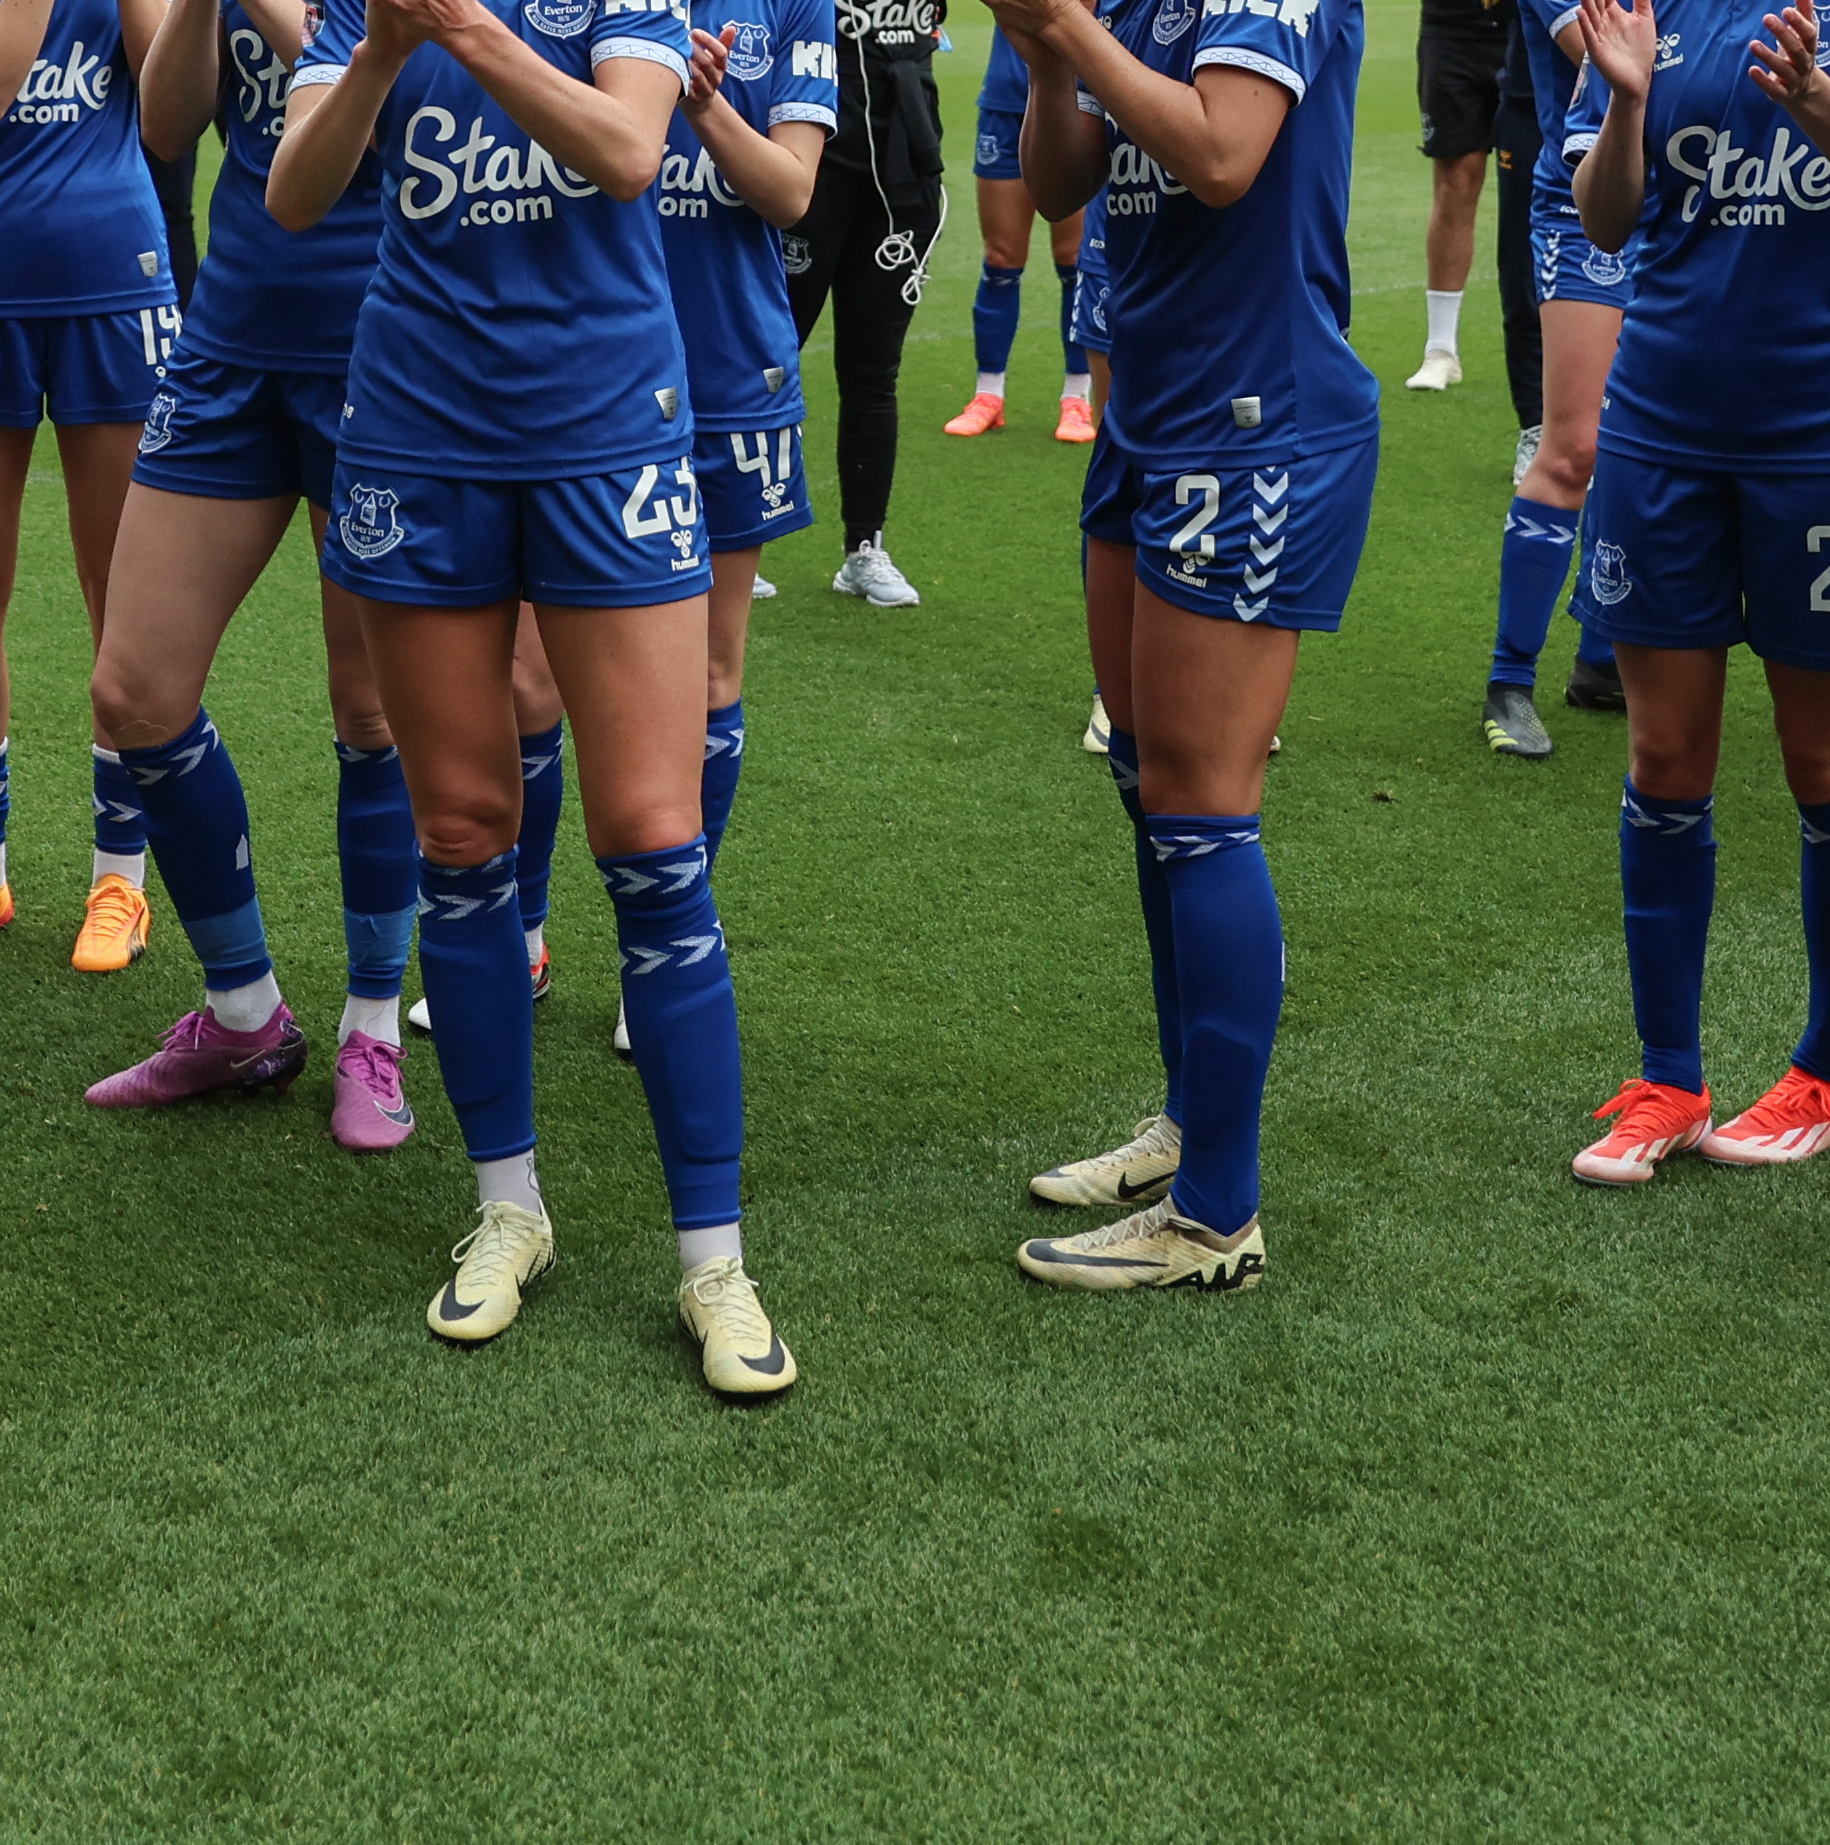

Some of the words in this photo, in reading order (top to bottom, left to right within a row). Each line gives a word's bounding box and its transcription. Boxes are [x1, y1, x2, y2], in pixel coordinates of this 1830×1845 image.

[544, 5, 582, 16] Everton
[875, 29, 915, 44] .com
[729, 50, 760, 64] Everton
[792, 40, 838, 86] KI
[16, 40, 112, 111] take
[9, 103, 79, 124] .com
[400, 106, 599, 220] Stak
[460, 194, 553, 227] .com
[658, 196, 708, 219] om
[1106, 190, 1157, 216] com
[1710, 202, 1785, 226] .com
[621, 455, 698, 540] 23
[761, 500, 795, 521] hummel
[1168, 474, 1220, 559] 2
[350, 521, 385, 537] Everton
[670, 554, 700, 572] hummel
[1166, 563, 1207, 589] hummel
